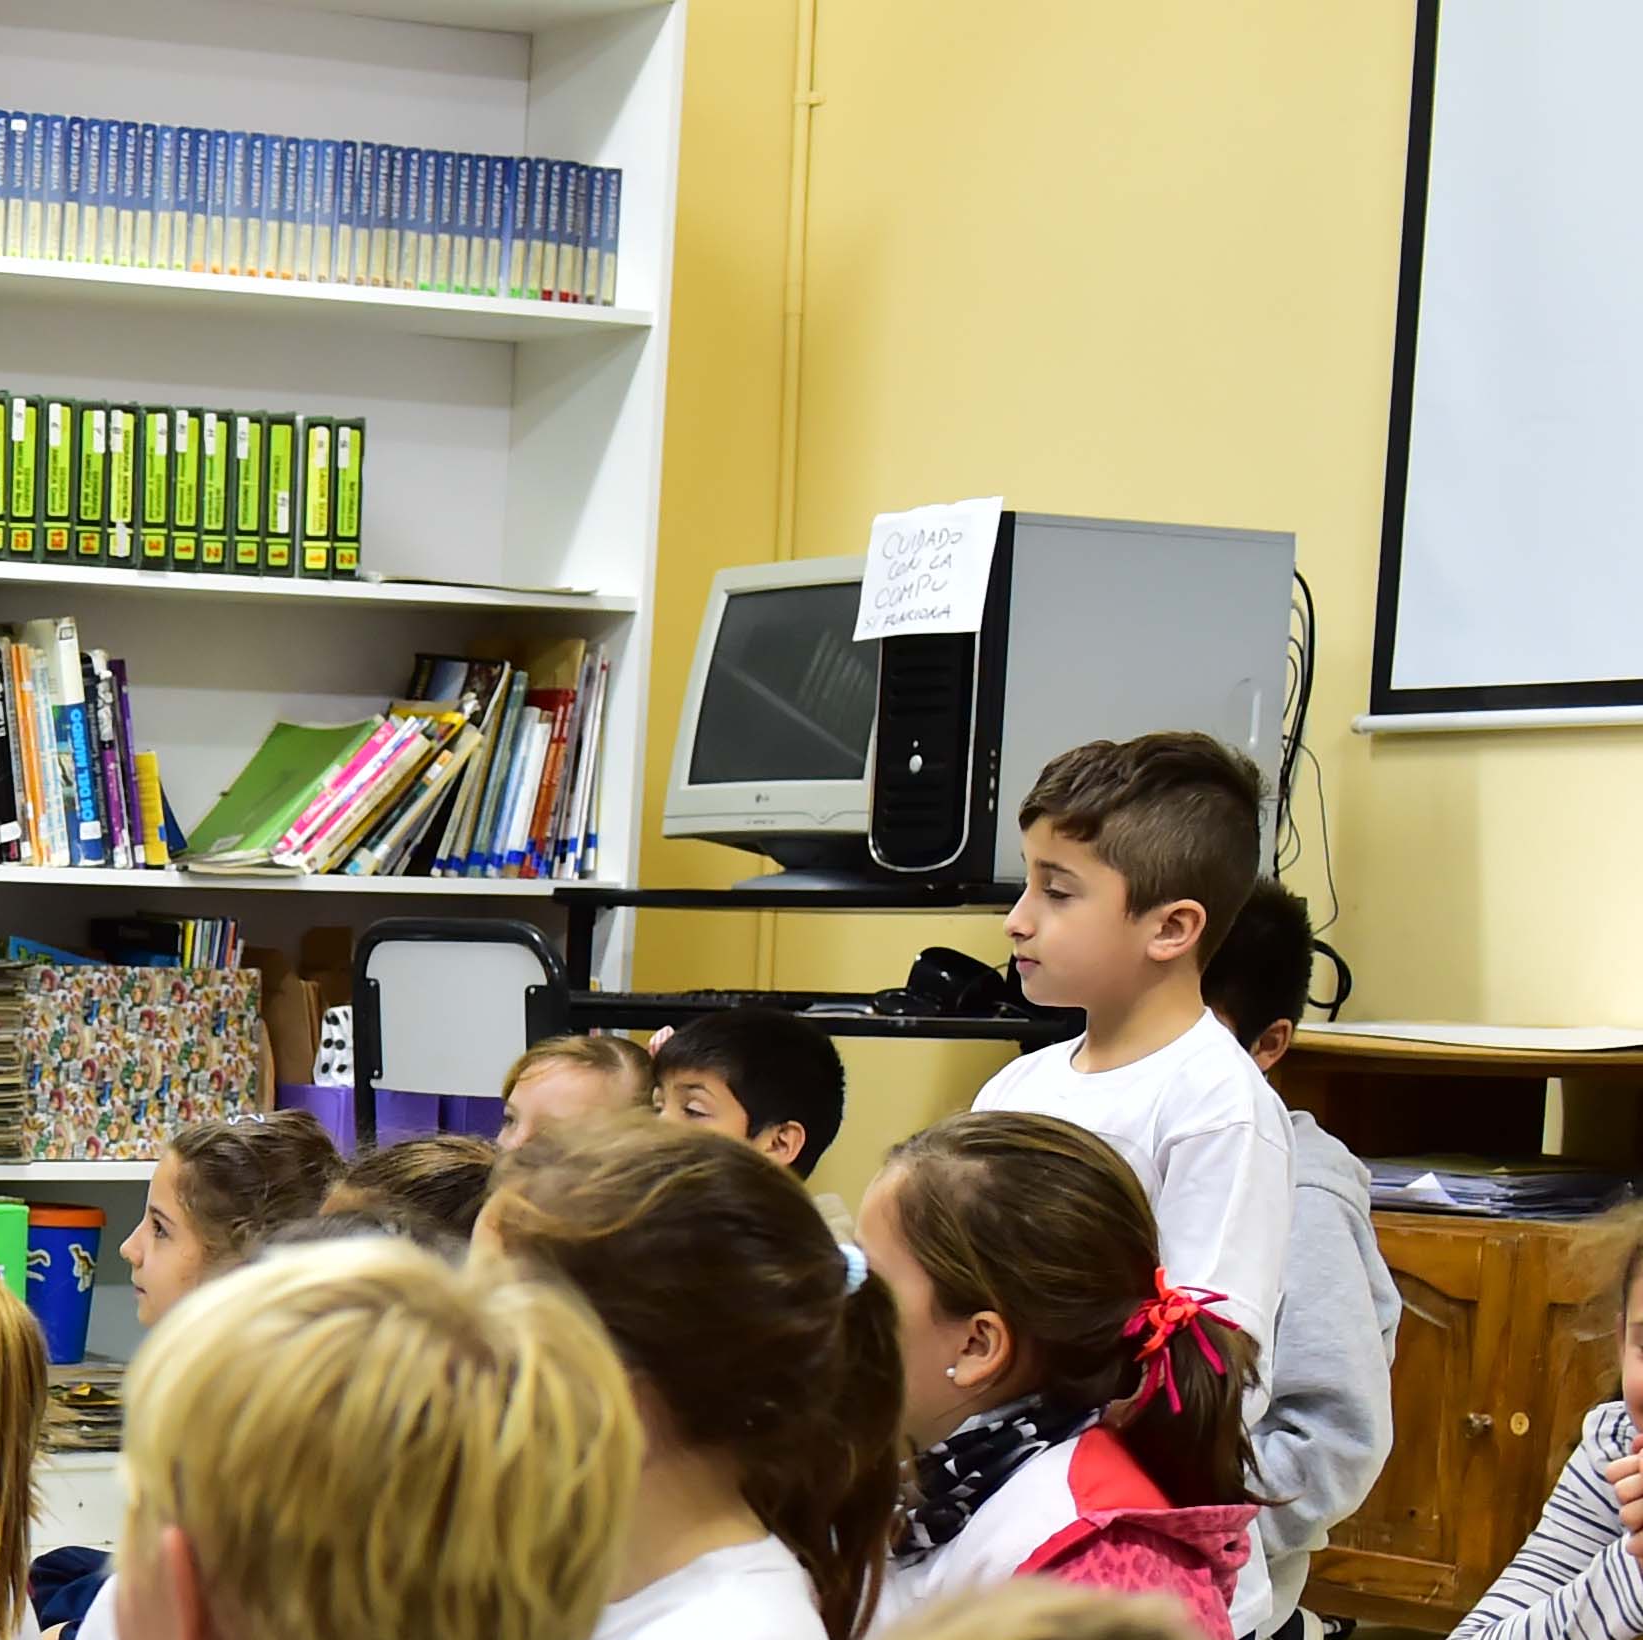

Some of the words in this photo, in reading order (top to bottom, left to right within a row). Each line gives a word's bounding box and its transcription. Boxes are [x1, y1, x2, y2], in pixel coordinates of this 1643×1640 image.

[13, 128, 26, 188] VIDEOTEC
[33, 120, 43, 190] VIDEOTECA
[51, 121, 62, 190] VIDEOTECA
[70, 122, 82, 192] VIDEOTECA
[88, 125, 100, 194] VIDEOTECA
[107, 125, 118, 194] VIDEOTECA
[124, 127, 136, 198] VIDEOTECA
[142, 130, 154, 198] VIDEOTECA
[162, 132, 172, 200] VIDEOTECA
[179, 132, 190, 200] VIDEOTECA
[197, 134, 207, 202] VIDEOTECA
[216, 136, 226, 205] VIDEOTECA
[234, 138, 244, 206] VIDEOTECA
[252, 140, 262, 208] VIDEOTECA
[271, 141, 281, 209] VIDEOTECA
[286, 143, 297, 211] VIDEOTECA
[303, 145, 315, 213] VIDEOTECA
[323, 146, 334, 214] VIDEOTECA
[343, 146, 353, 214] VIDEOTECA
[361, 148, 371, 216] VIDEOTECA
[378, 150, 389, 217] VIDEOTECA
[392, 151, 403, 219] VIDEOTECA
[408, 153, 418, 220] VIDEOTECA
[425, 155, 434, 223] VIDEOTECA
[442, 157, 452, 223] VIDEOTECA
[459, 159, 468, 225] VIDEOTECA
[475, 161, 485, 227] VIDEOTECA
[492, 162, 503, 229] VIDEOTECA
[515, 162, 527, 229] VIDEOTECA
[534, 163, 544, 229] VIDEOTECA
[549, 165, 559, 231] VIDEOTECA
[566, 168, 576, 233] VIDEOTECA
[592, 171, 602, 237] VIDEOTECA
[608, 174, 618, 240] VIDEOTECA
[883, 528, 963, 559] CUIDADO
[888, 557, 922, 580] CON
[875, 573, 948, 609] COMPU
[70, 709, 91, 767] MUNDO
[77, 770, 92, 798] DEL
